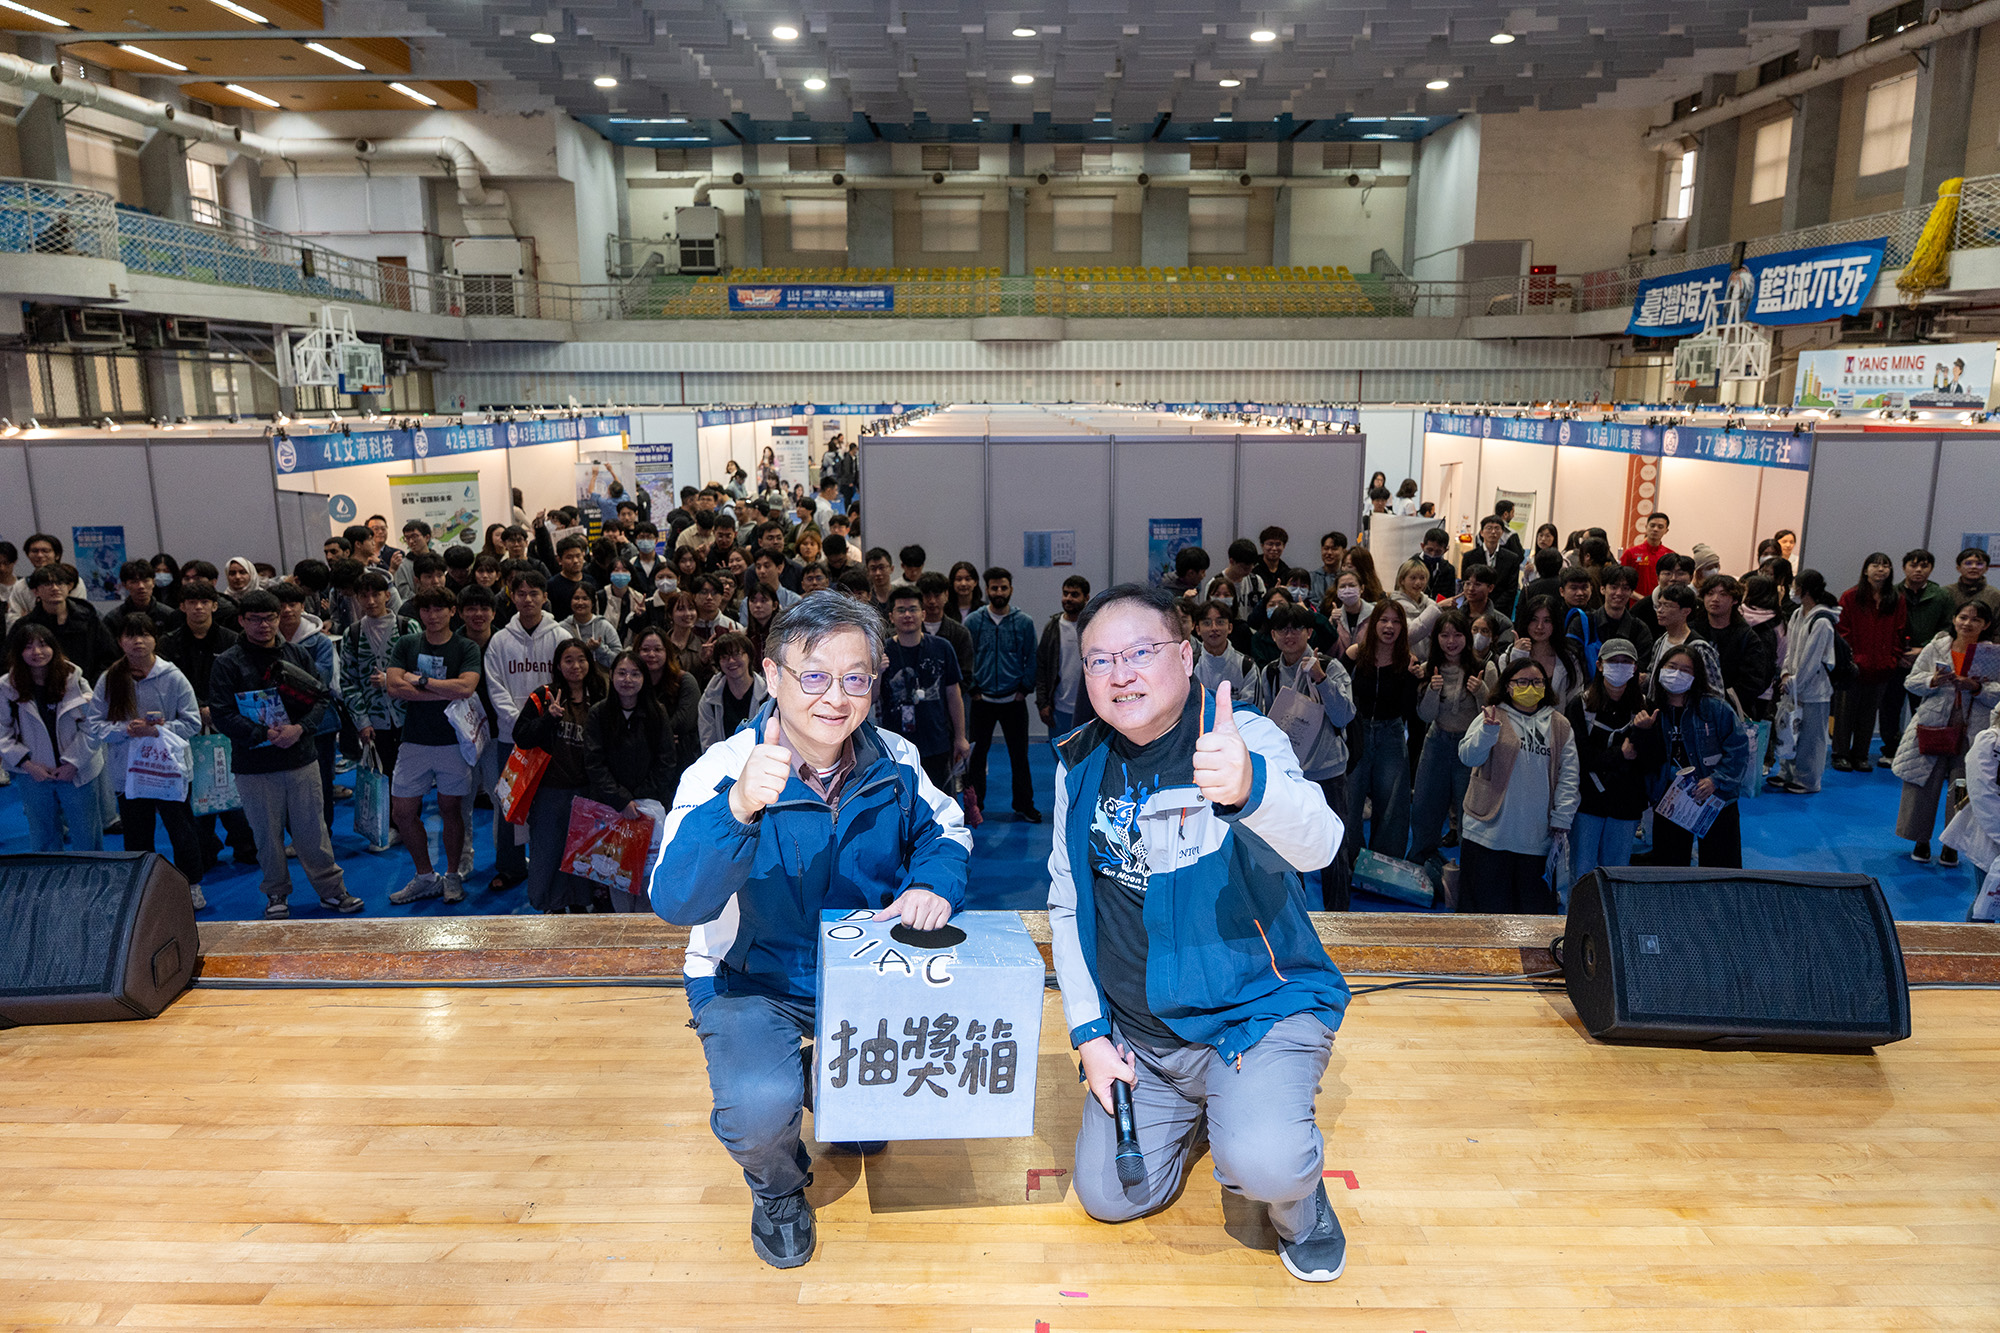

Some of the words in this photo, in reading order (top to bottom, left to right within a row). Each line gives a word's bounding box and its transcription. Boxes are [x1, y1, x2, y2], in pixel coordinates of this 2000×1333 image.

[1634, 277, 1723, 327] 臺灣海大
[1755, 255, 1872, 314] 籃球不死
[1858, 356, 1888, 372] YANG
[1890, 355, 1925, 370] MING
[324, 435, 395, 462] 41艾滴科技
[445, 428, 494, 449] 42台塑海運
[1694, 433, 1792, 463] 17雄獅旅行社
[1101, 867, 1116, 878] Sun
[1116, 871, 1142, 885] Moon
[828, 1012, 1018, 1098] 抽獎箱
